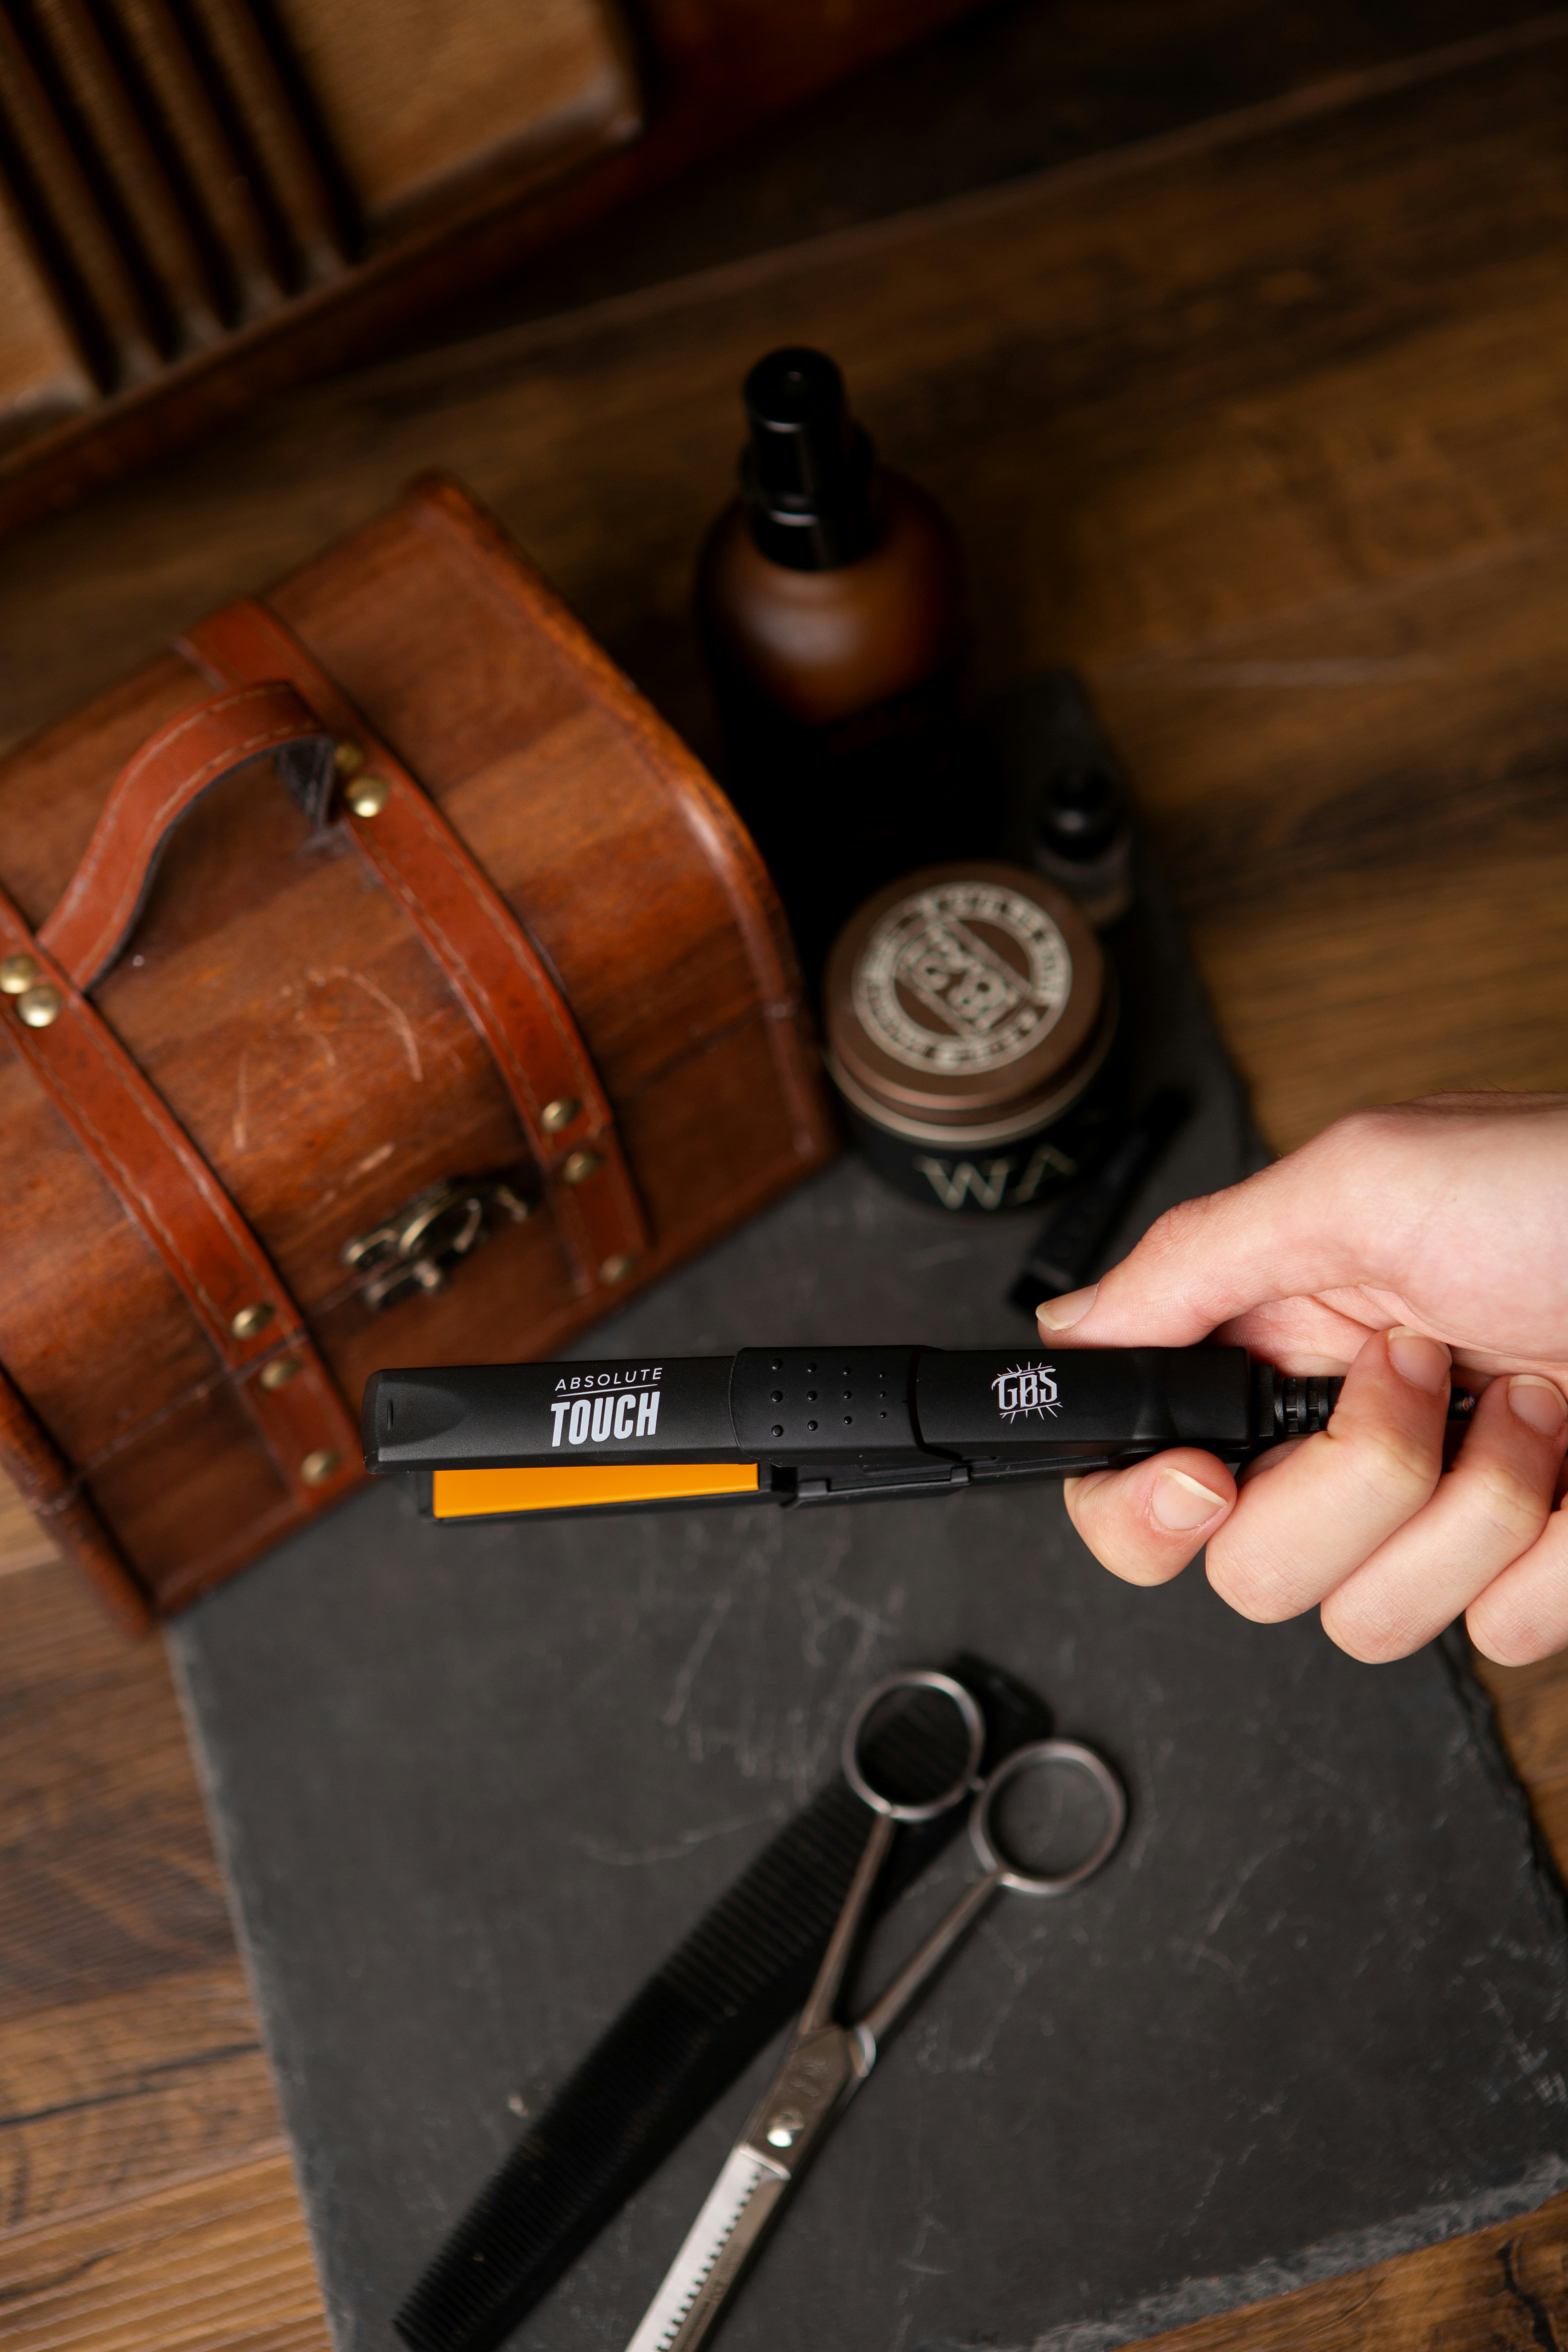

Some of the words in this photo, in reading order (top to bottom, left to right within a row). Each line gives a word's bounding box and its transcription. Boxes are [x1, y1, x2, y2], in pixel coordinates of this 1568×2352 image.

[913, 1137, 1098, 1209] WA
[555, 1368, 663, 1391] ABSOLUTE
[991, 1368, 1058, 1410] GBS
[551, 1391, 660, 1447] TOUCH
